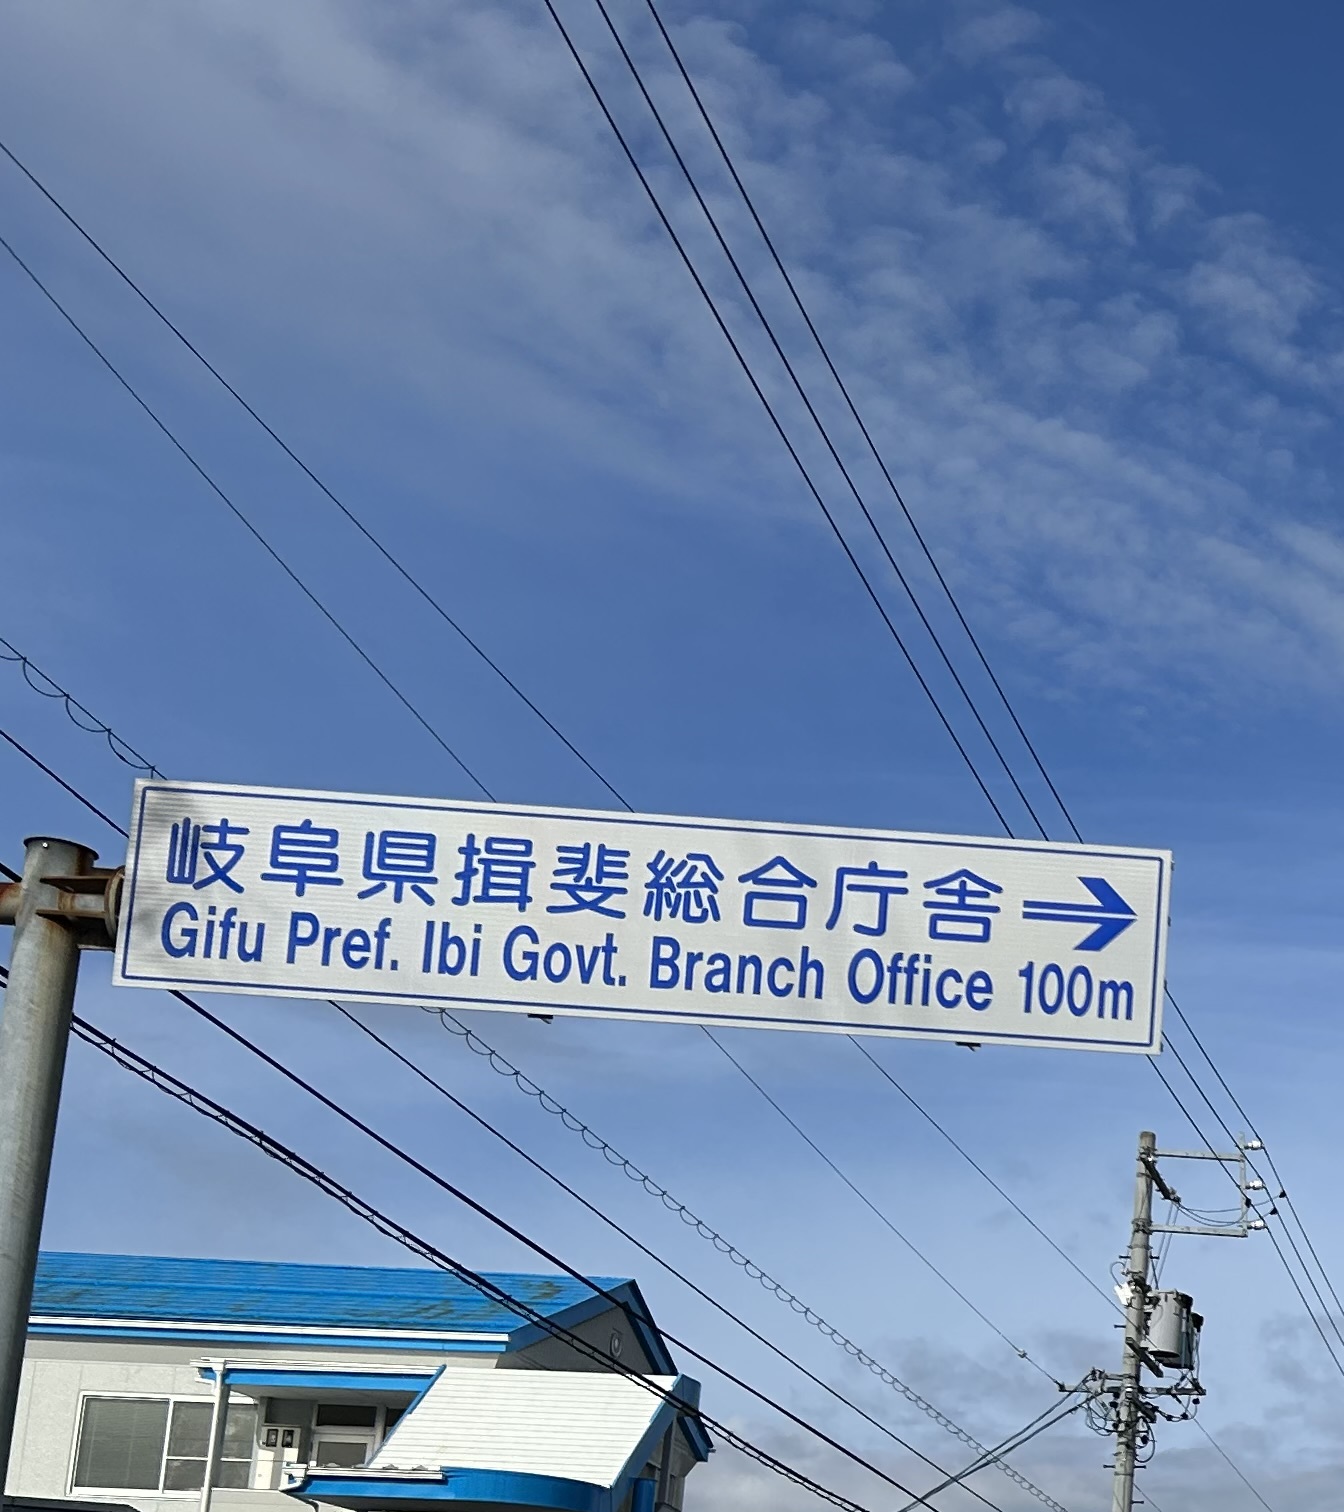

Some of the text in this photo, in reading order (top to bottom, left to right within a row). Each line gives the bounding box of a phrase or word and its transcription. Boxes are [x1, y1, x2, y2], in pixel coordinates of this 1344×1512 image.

[166, 816, 1001, 945] 岐阜県揖斐総合庁舎
[161, 901, 1134, 1021] Gifu Pref. Ibi Govt. Branch Office 100m
